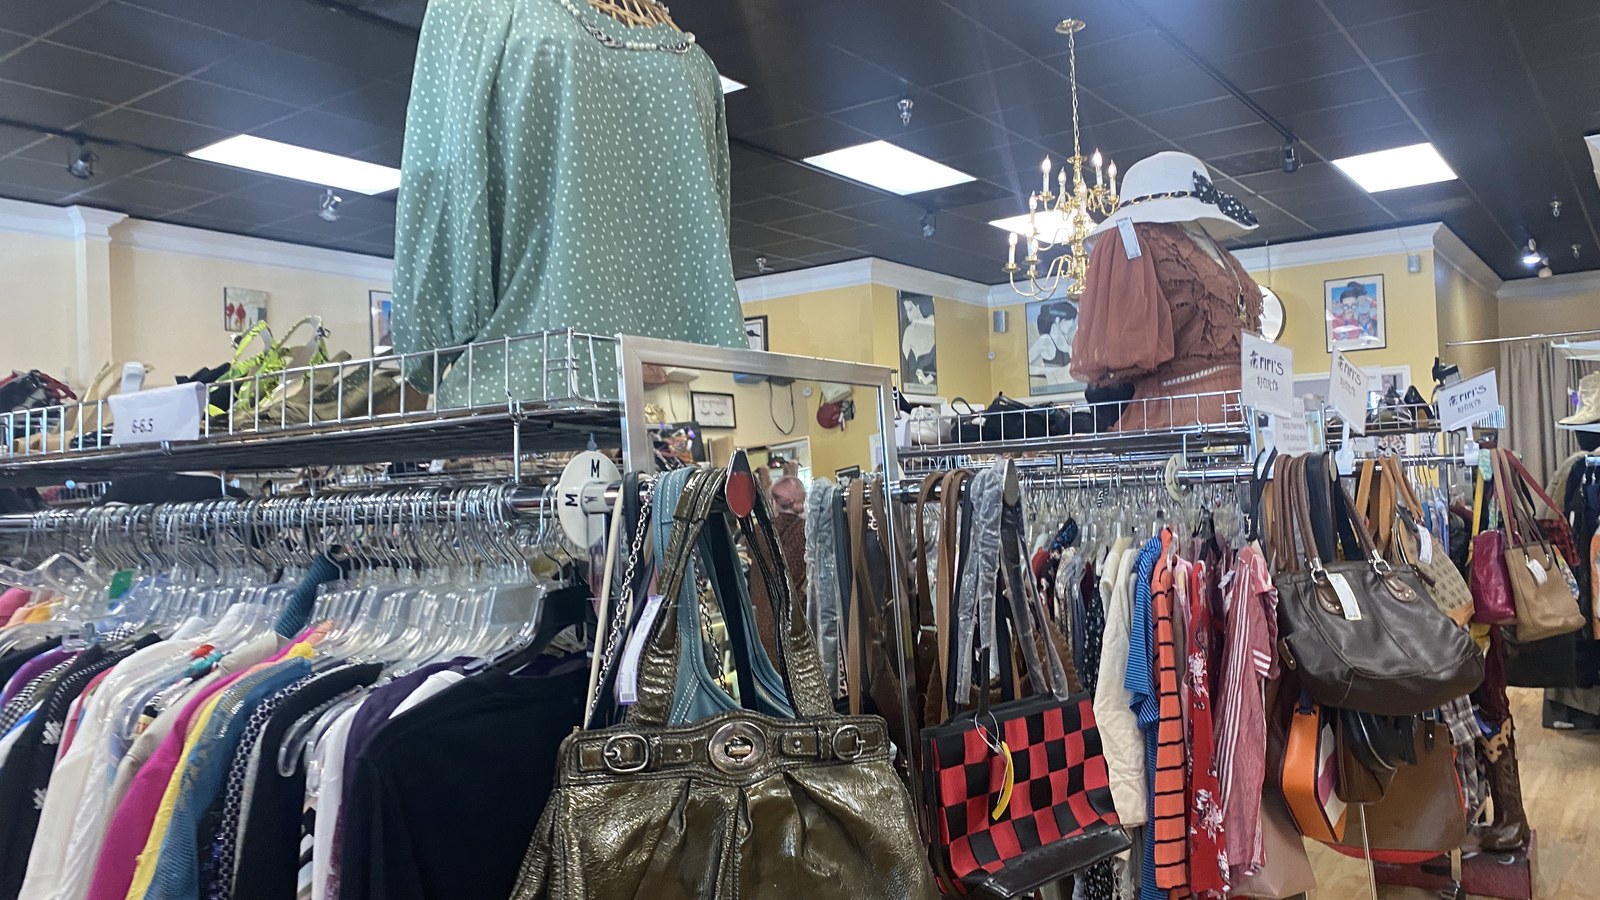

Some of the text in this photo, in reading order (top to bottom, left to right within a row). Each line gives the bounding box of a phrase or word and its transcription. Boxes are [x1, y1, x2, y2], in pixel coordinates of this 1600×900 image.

[1260, 357, 1284, 376] FIFI'S
[591, 459, 600, 478] M
[565, 494, 578, 507] M
